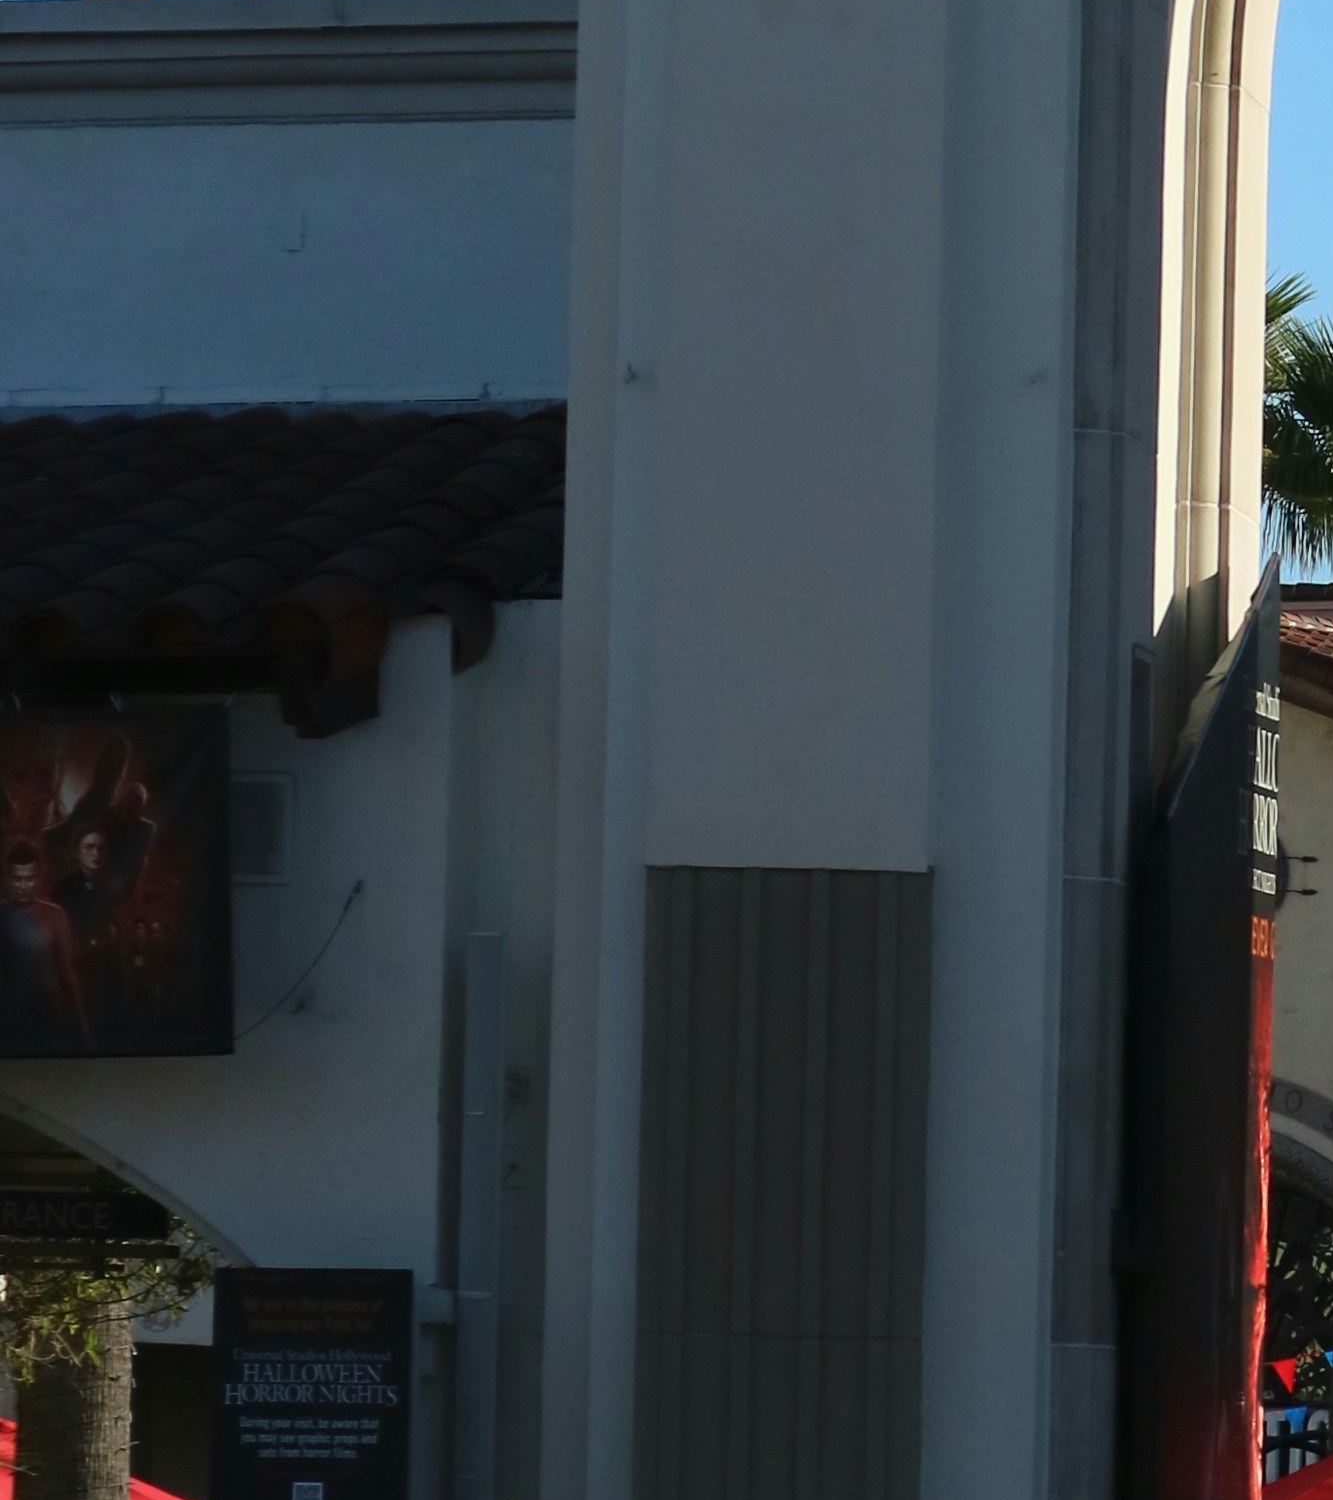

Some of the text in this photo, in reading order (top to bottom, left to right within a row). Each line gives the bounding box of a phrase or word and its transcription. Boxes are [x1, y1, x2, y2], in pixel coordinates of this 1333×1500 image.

[0, 1201, 111, 1229] RANCE
[232, 1348, 391, 1362] Universal Studios Hollywood
[241, 1363, 383, 1384] HALLOWEEN
[224, 1384, 400, 1407] HORROR NIGHTS
